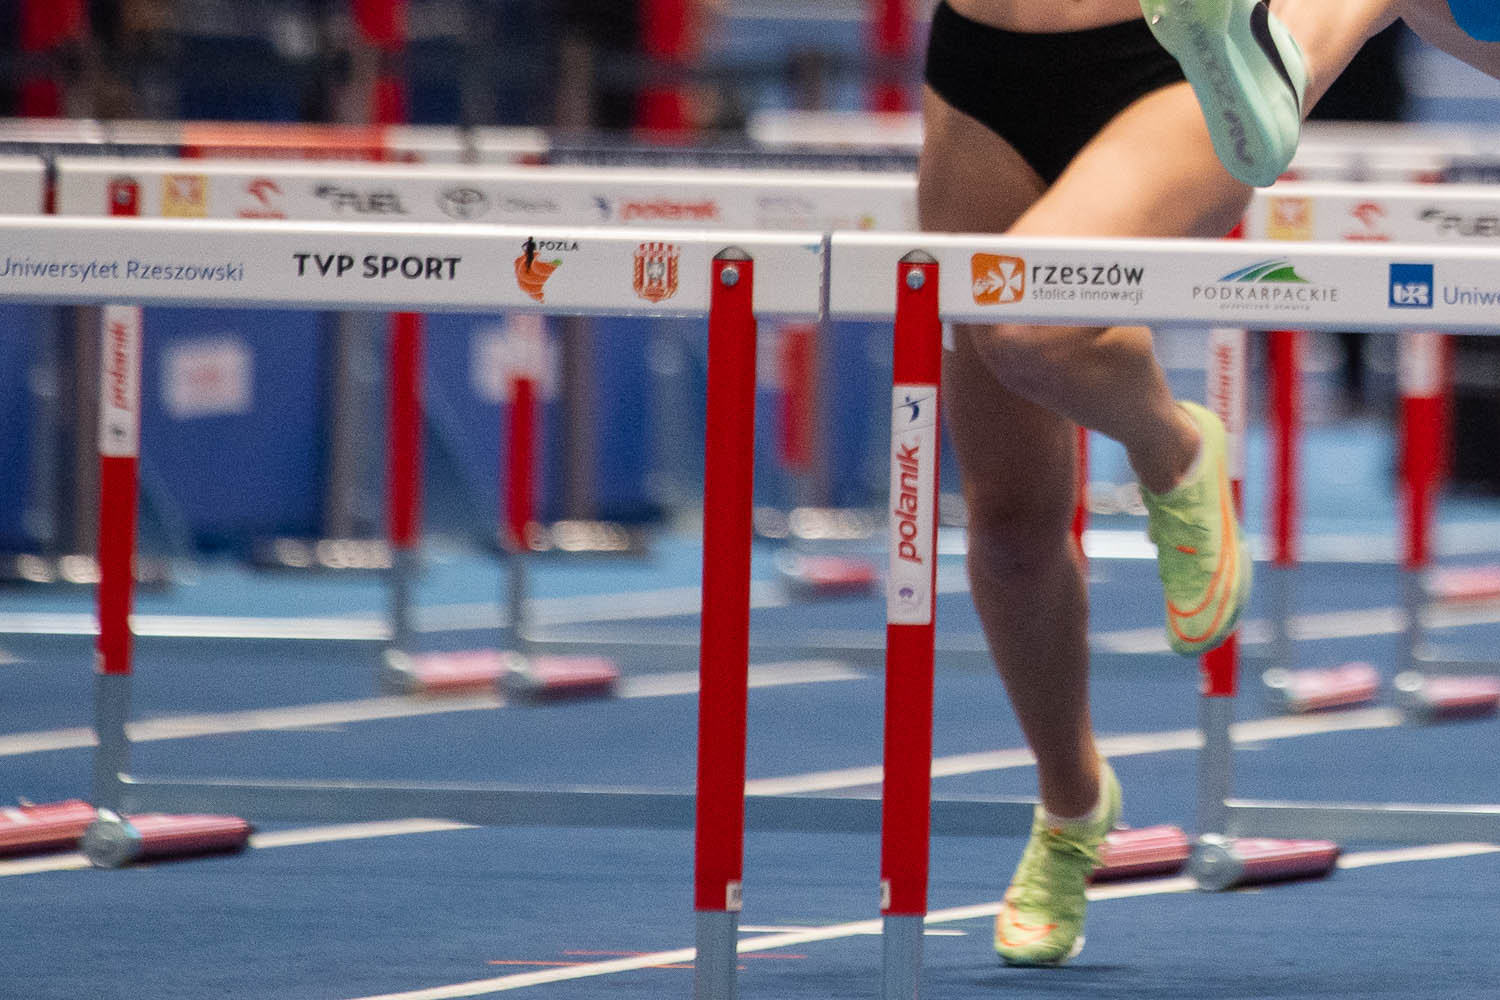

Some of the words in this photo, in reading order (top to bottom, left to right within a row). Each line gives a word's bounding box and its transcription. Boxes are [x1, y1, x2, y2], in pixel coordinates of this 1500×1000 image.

[126, 259, 244, 282] Rzeszowski
[293, 253, 354, 278] TVP
[362, 254, 462, 281] SPORT
[1031, 262, 1145, 287] rzeszów
[1031, 286, 1076, 300] stolica
[1080, 287, 1144, 305] innowacji
[1192, 286, 1339, 303] PODKARPACKIE
[894, 441, 924, 565] polanik
